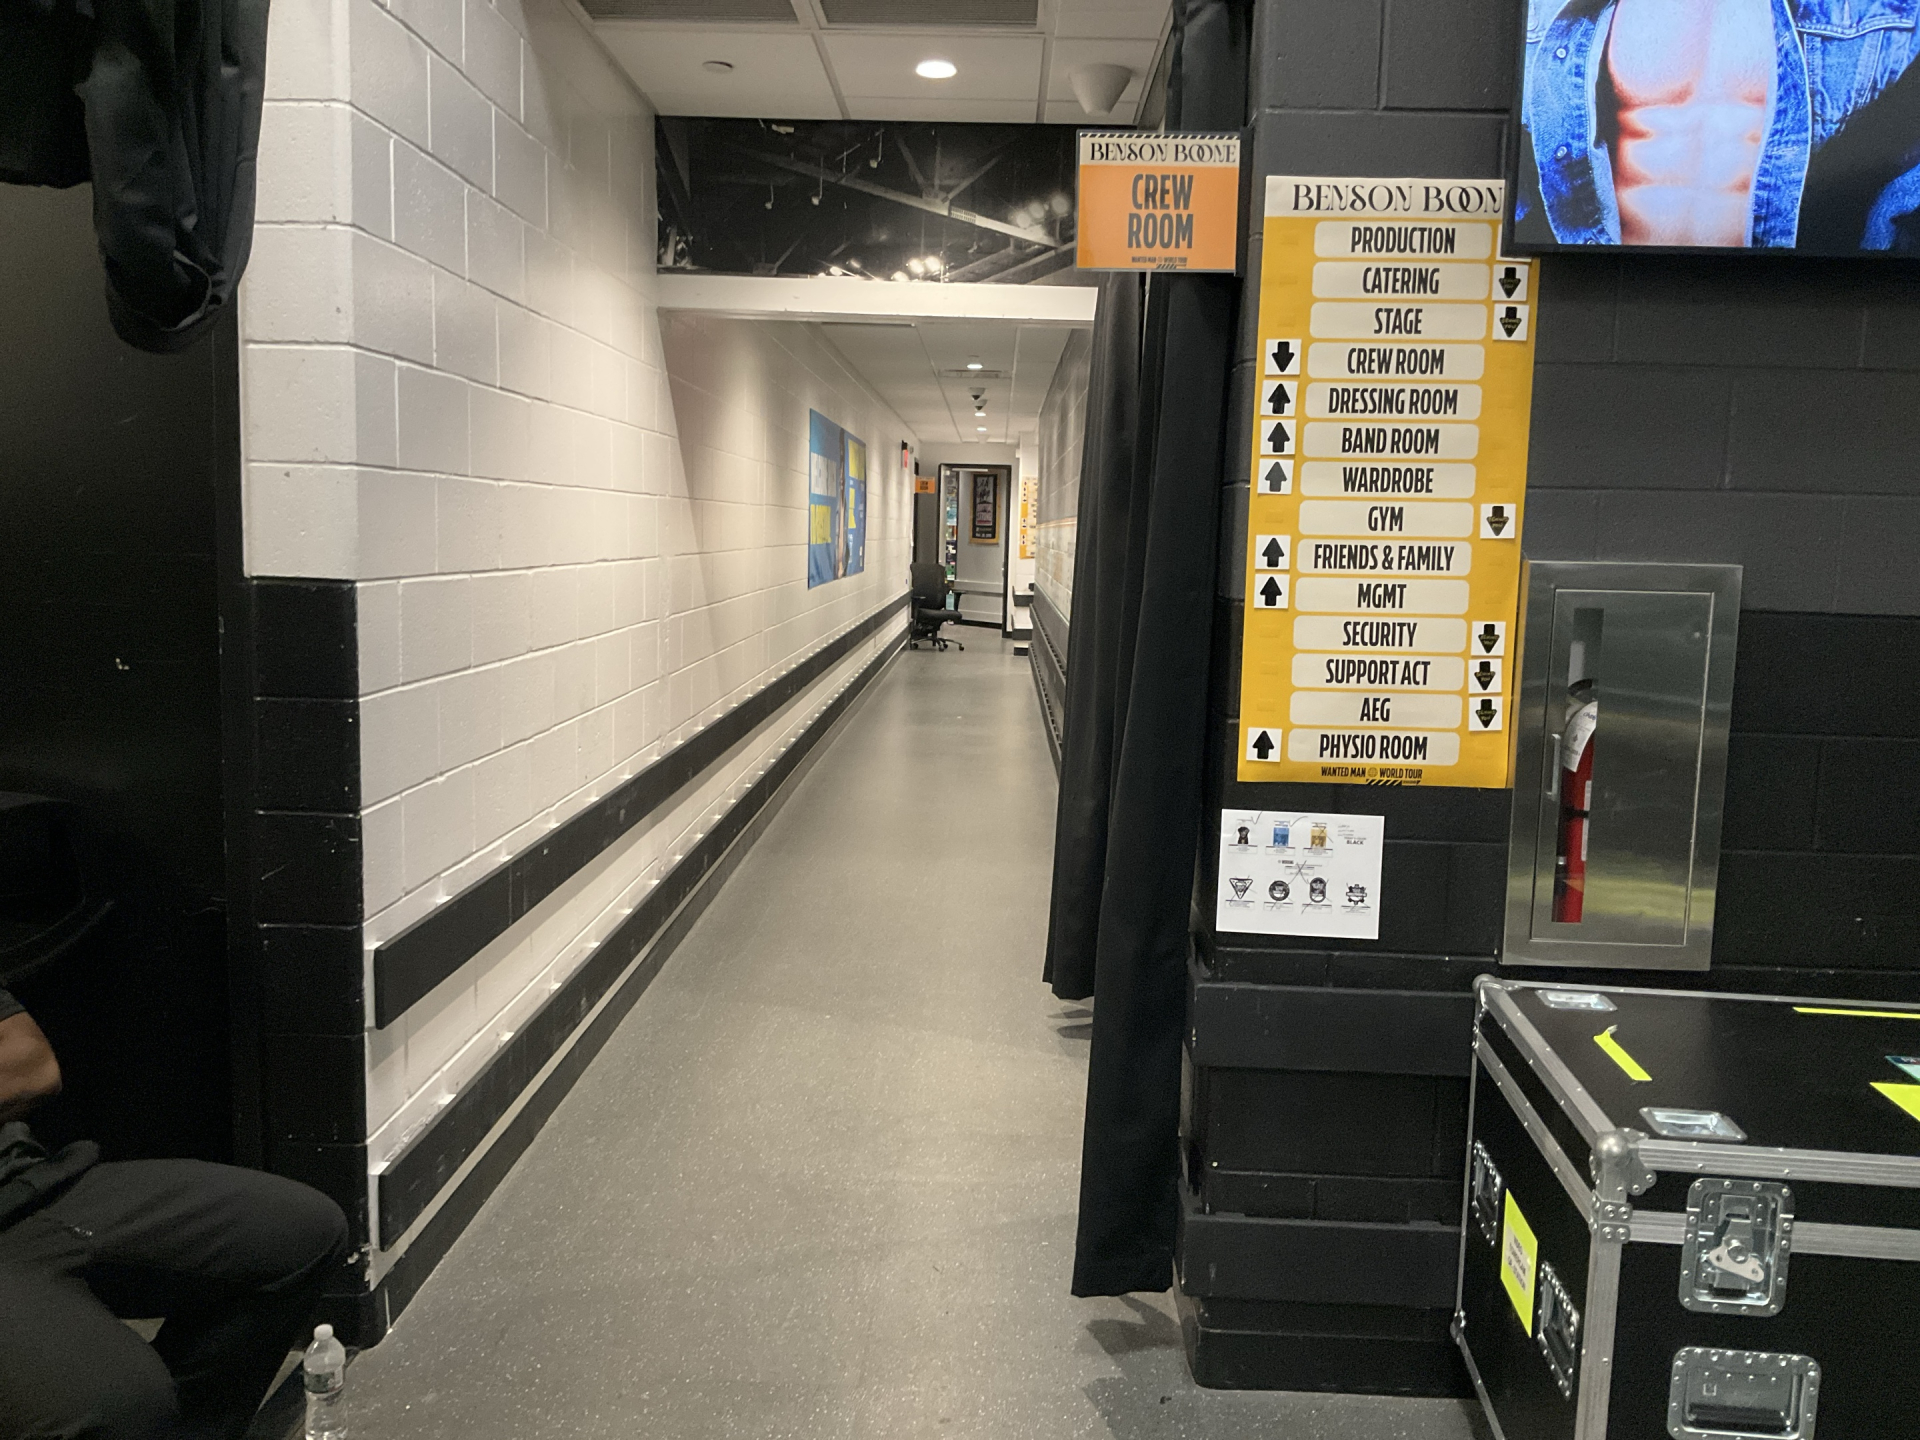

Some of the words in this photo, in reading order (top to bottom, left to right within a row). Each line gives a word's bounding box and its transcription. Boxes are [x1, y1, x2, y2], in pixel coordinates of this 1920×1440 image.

[1091, 143, 1167, 161] BENSON
[1175, 144, 1235, 162] BOONE
[1133, 174, 1193, 210] CREW
[1293, 185, 1412, 211] BENSON
[1424, 187, 1501, 213] BOON
[1128, 213, 1193, 249] ROOM
[1352, 227, 1455, 253] PRODUCTION
[1363, 268, 1439, 294] CATERING
[1374, 308, 1422, 334] STAGE
[1348, 348, 1397, 374] CREW
[1396, 349, 1444, 374] ROOM
[1329, 388, 1405, 414] DRESSING
[1409, 389, 1458, 414] ROOM
[1342, 428, 1386, 453] BAND
[1391, 429, 1439, 454] ROOM
[1343, 467, 1433, 493] WARDROBE
[1368, 506, 1403, 531] GYM
[1314, 544, 1378, 569] FRIENDS
[1382, 545, 1393, 570] &
[1398, 546, 1454, 571] FAMILY
[1358, 584, 1406, 608] MGMT
[1343, 622, 1417, 647] SECURITY
[1326, 659, 1399, 684] SUPPORT
[1401, 661, 1430, 685] ACT
[1360, 698, 1390, 722] AEG
[1320, 734, 1375, 758] PHYSIO
[1380, 736, 1427, 760] ROOM
[1321, 766, 1349, 776] WANTED
[1350, 767, 1366, 777] MAN
[1380, 768, 1404, 778] WORLD
[1405, 769, 1422, 779] TOUR
